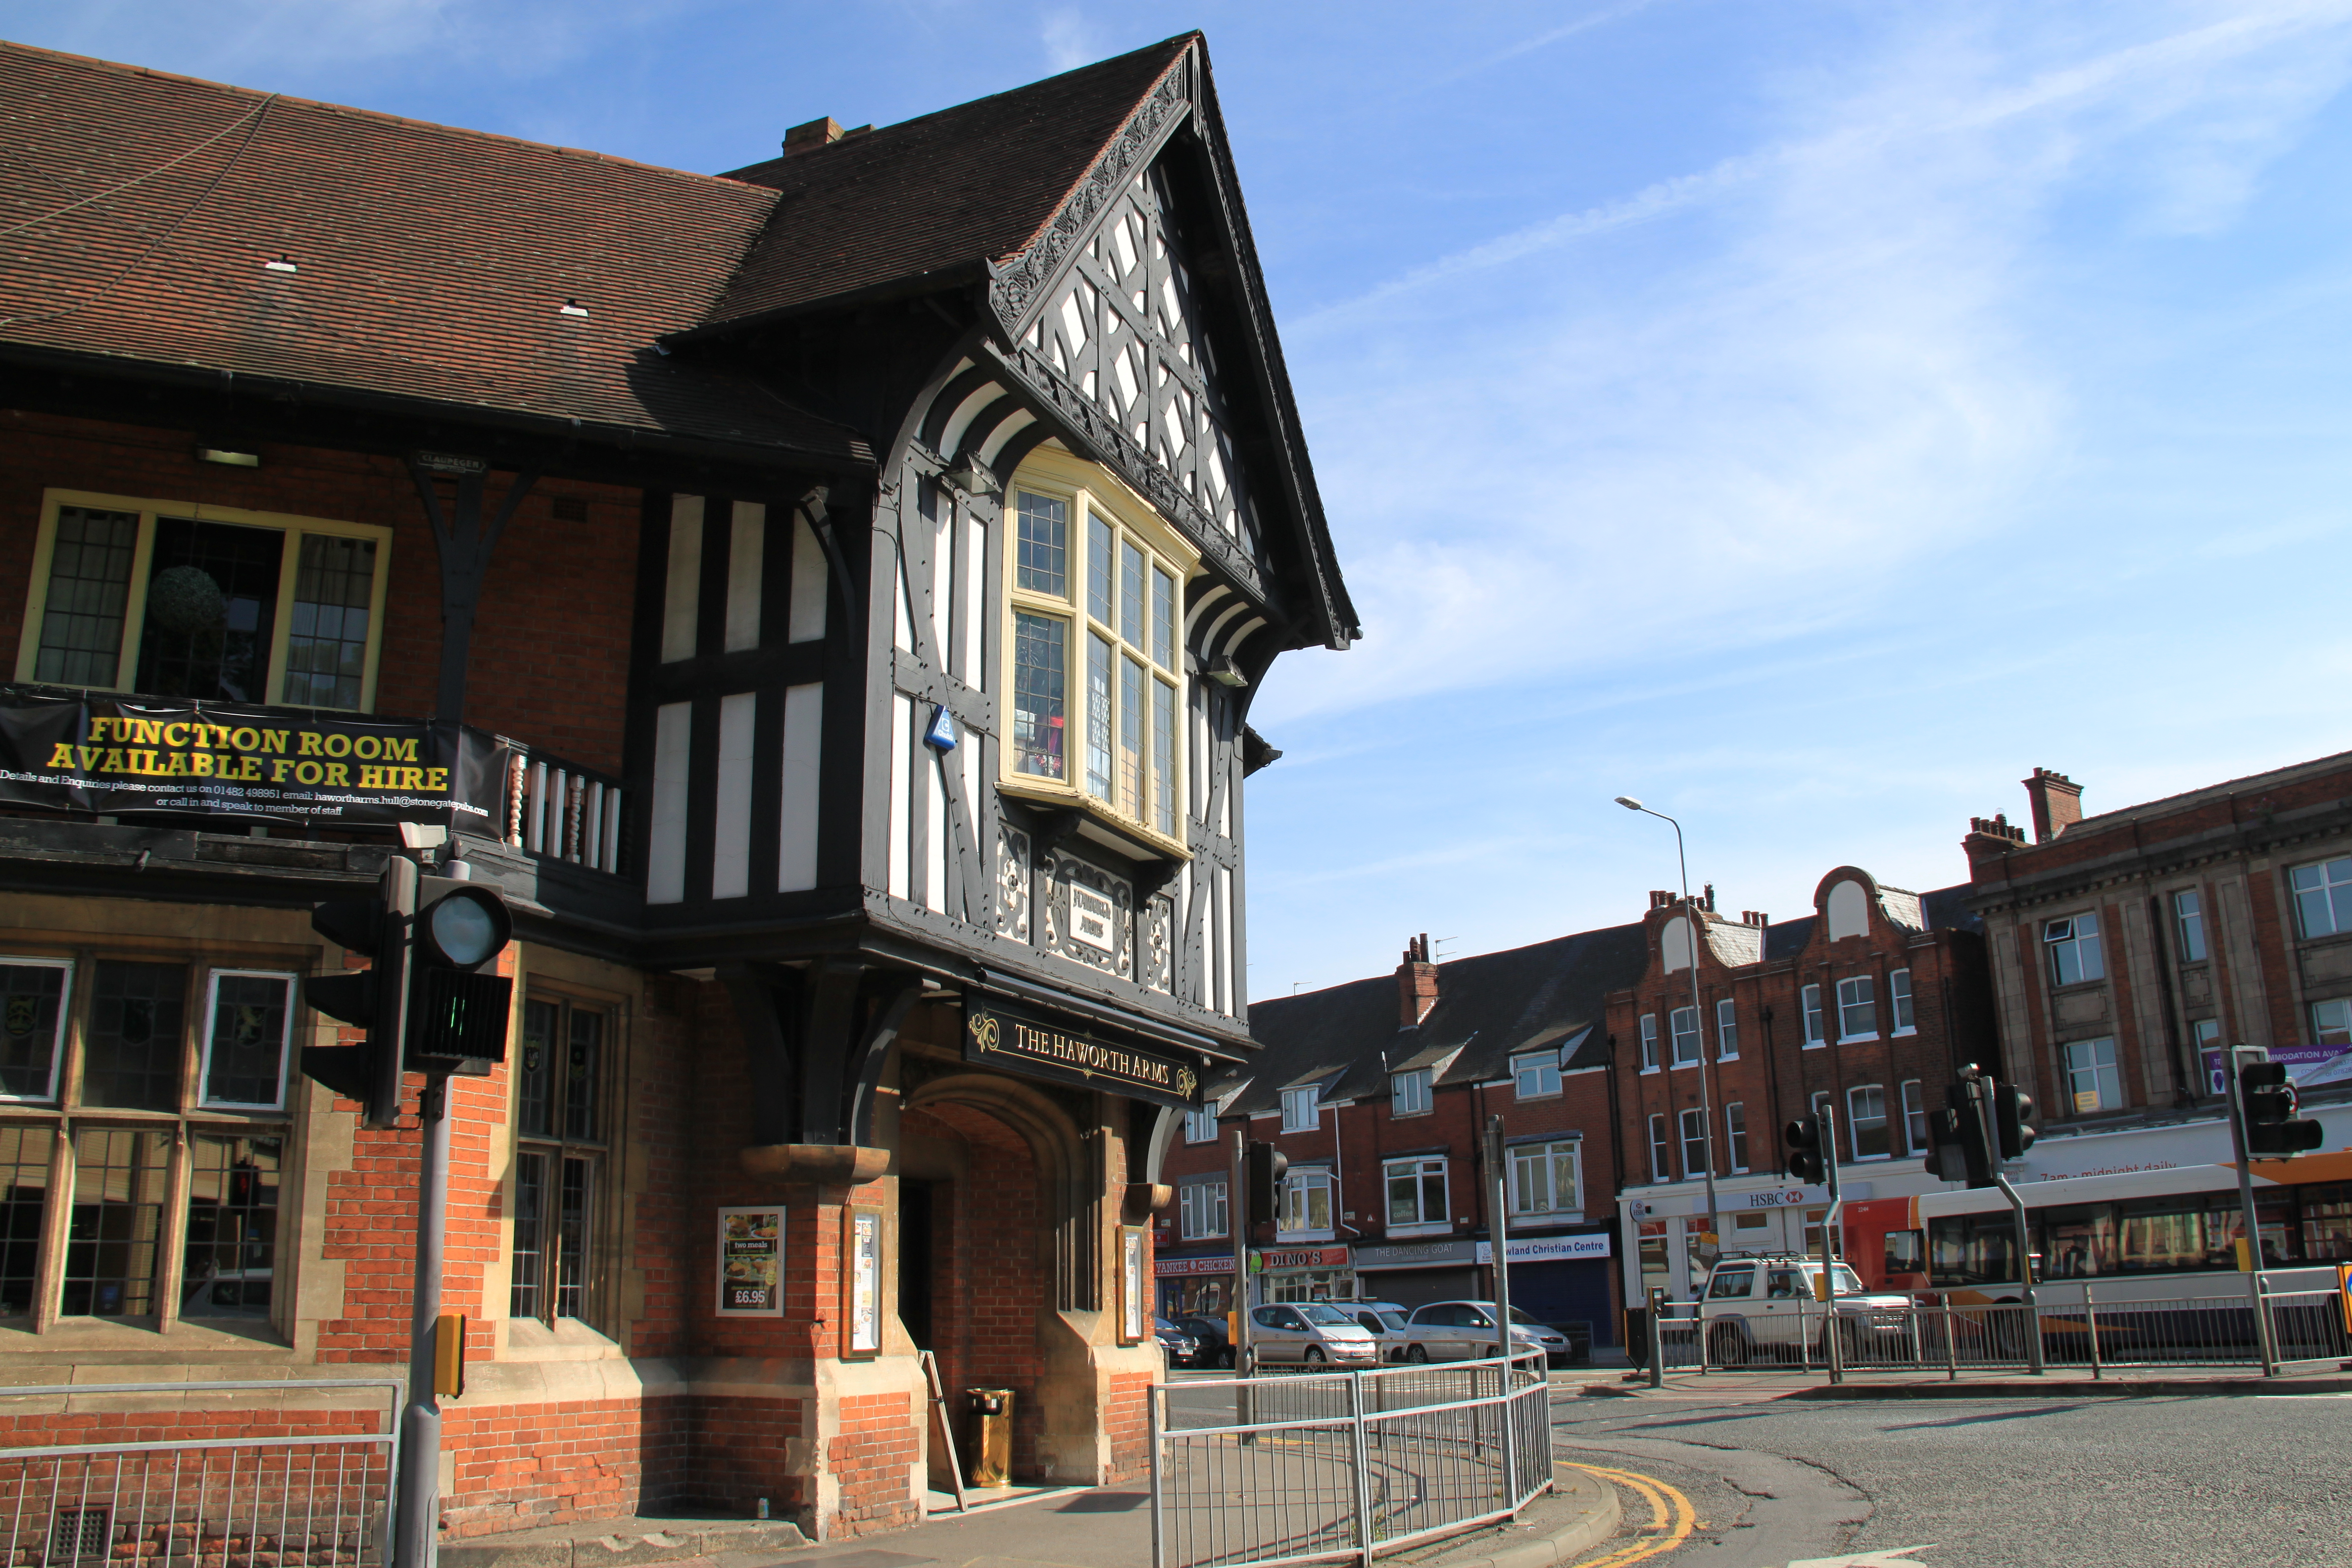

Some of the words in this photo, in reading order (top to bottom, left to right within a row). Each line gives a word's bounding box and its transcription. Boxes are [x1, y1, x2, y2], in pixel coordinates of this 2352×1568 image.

[88, 717, 291, 754] FUNCTION
[297, 732, 419, 762] ROOM
[938, 729, 953, 741] Chubb
[47, 742, 263, 781] AVAILABLE
[271, 759, 350, 787] FOR
[358, 764, 448, 791] HIRE
[0, 769, 37, 782] Details
[38, 775, 60, 784] and
[60, 776, 111, 789] Enquiries
[111, 781, 146, 792] please
[147, 784, 185, 793] contact
[214, 785, 244, 796] 01482
[246, 787, 280, 799] 498951
[283, 791, 313, 800] email:
[314, 792, 489, 817] hawortharms.hull@stonegatepubs.com
[169, 797, 188, 806] call
[189, 797, 199, 806] in
[201, 799, 220, 808] and
[221, 801, 252, 811] speak
[254, 803, 264, 812] to
[265, 804, 310, 814] member
[311, 805, 322, 814] of
[322, 806, 343, 816] staff
[1015, 1024, 1049, 1054] THE
[1053, 1033, 1129, 1075] HAWORTH
[1132, 1055, 1169, 1085] ARMS
[2268, 1050, 2320, 1061] MMODATION
[1750, 1192, 1784, 1207] HSBC
[1375, 1248, 1390, 1257] THE
[1393, 1245, 1429, 1256] DANCING
[1431, 1243, 1454, 1254] GOAT
[1506, 1244, 1530, 1256] wland
[1532, 1243, 1572, 1255] Christian
[1574, 1241, 1604, 1252] Centre
[1156, 1260, 1188, 1274] YANKEE
[1198, 1259, 1235, 1272] CHICKEN
[1270, 1251, 1321, 1267] DINO'S
[735, 1290, 766, 1303] £6.95
